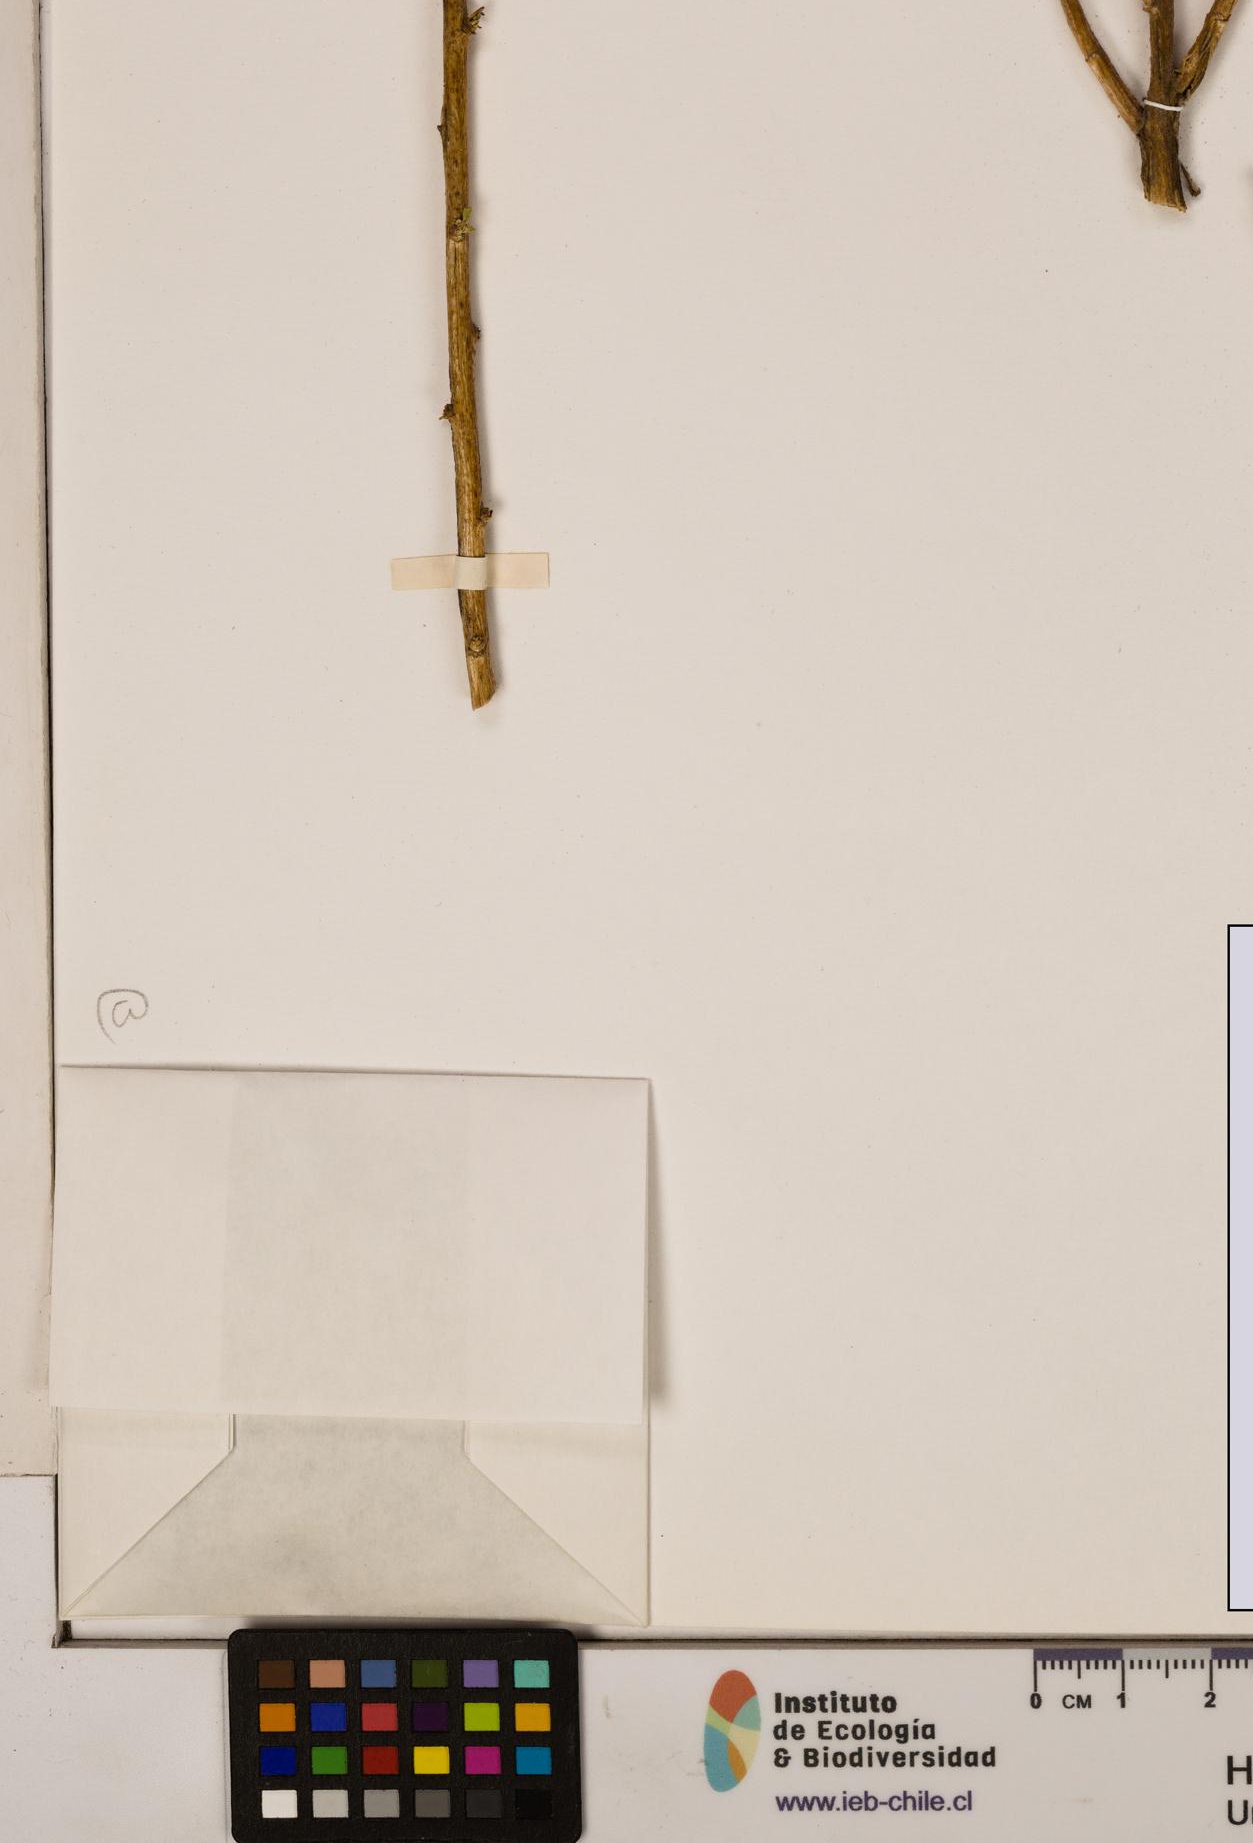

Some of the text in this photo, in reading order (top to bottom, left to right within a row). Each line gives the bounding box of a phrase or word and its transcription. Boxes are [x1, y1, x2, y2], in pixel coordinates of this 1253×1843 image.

[774, 1690, 898, 1714] Instituto
[1029, 1692, 1043, 1710] 0
[1061, 1694, 1092, 1710] CM
[1116, 1691, 1126, 1709] 1
[1203, 1691, 1217, 1709] 2
[772, 1718, 936, 1745] de Ecología
[773, 1745, 996, 1769] & Biodiversidad
[775, 1790, 973, 1812] www.ieb-chile.cl
